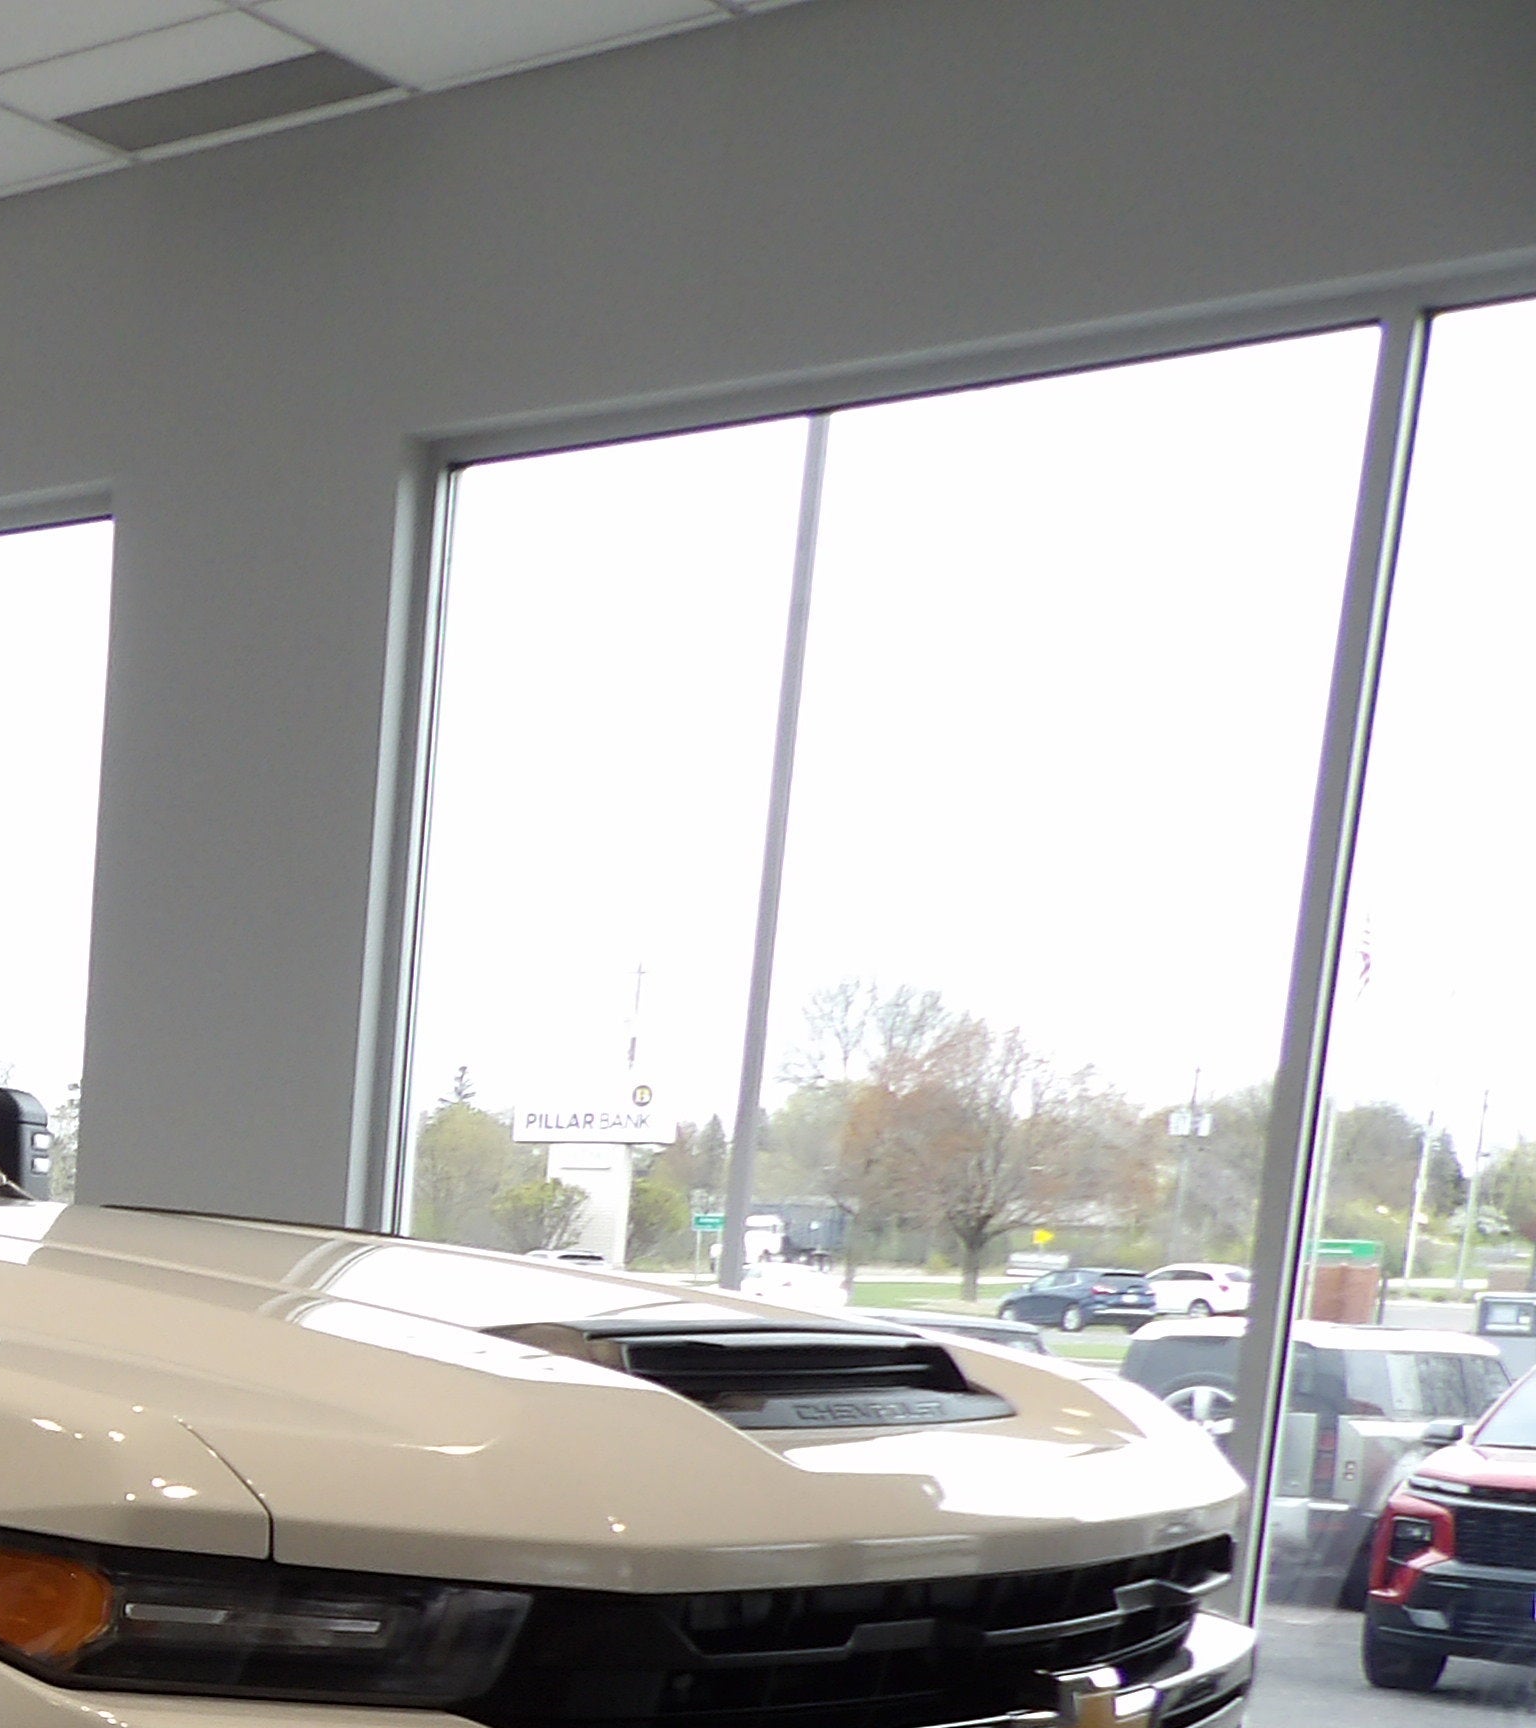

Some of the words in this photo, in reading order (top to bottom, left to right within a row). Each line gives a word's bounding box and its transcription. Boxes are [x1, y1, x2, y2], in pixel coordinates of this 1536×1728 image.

[525, 1113, 595, 1130] PILLAR
[599, 1112, 651, 1130] BANK
[791, 1401, 946, 1422] CHEVROLET
